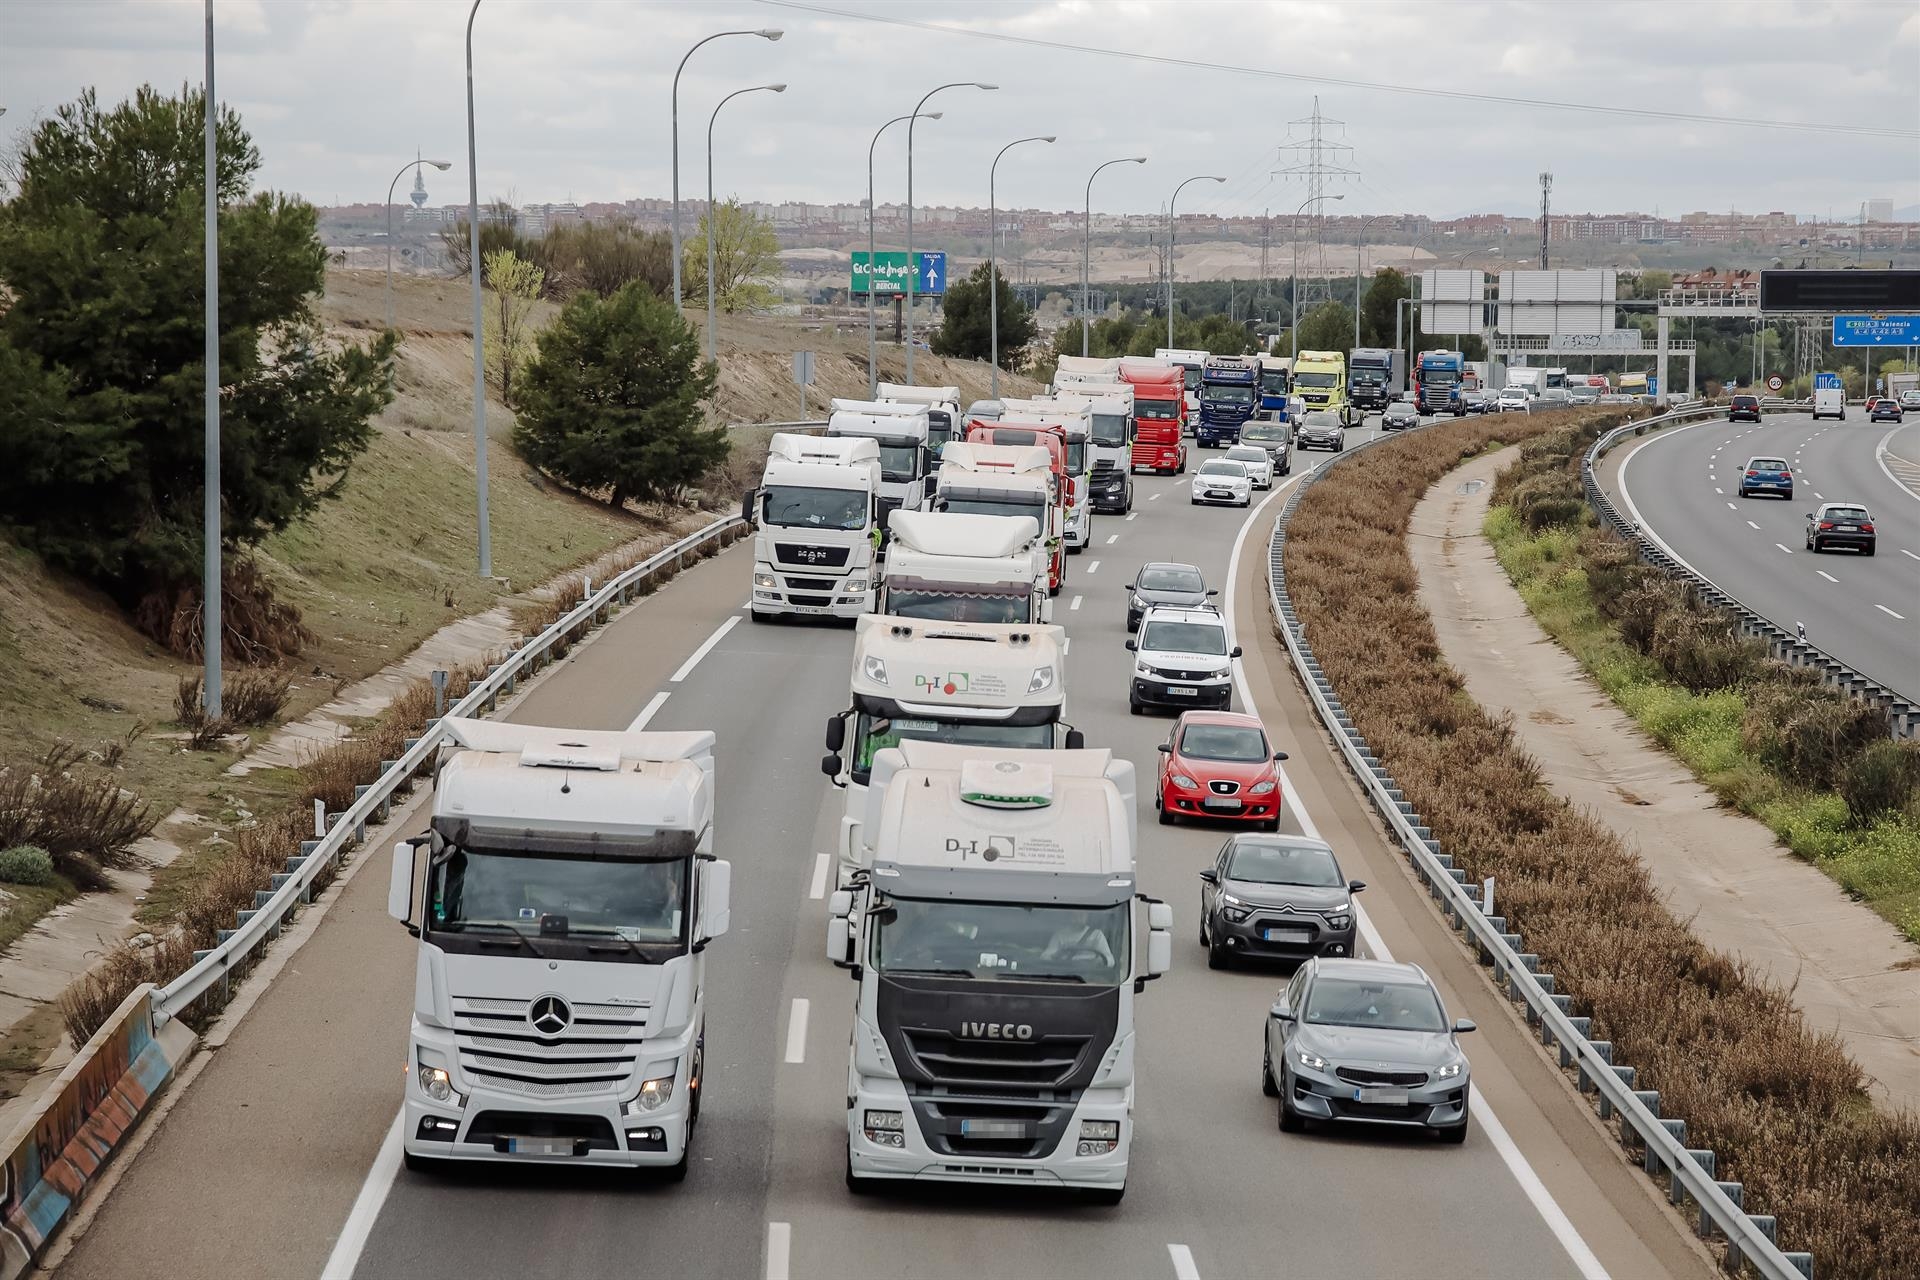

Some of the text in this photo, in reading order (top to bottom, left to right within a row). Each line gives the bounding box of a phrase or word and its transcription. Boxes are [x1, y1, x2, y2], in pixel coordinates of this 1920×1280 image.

[853, 263, 864, 274] El
[886, 261, 919, 278] Ingls
[797, 550, 827, 559] MAN
[915, 675, 941, 694] DTI
[946, 838, 978, 861] DTI
[961, 1021, 1033, 1040] IVECO
